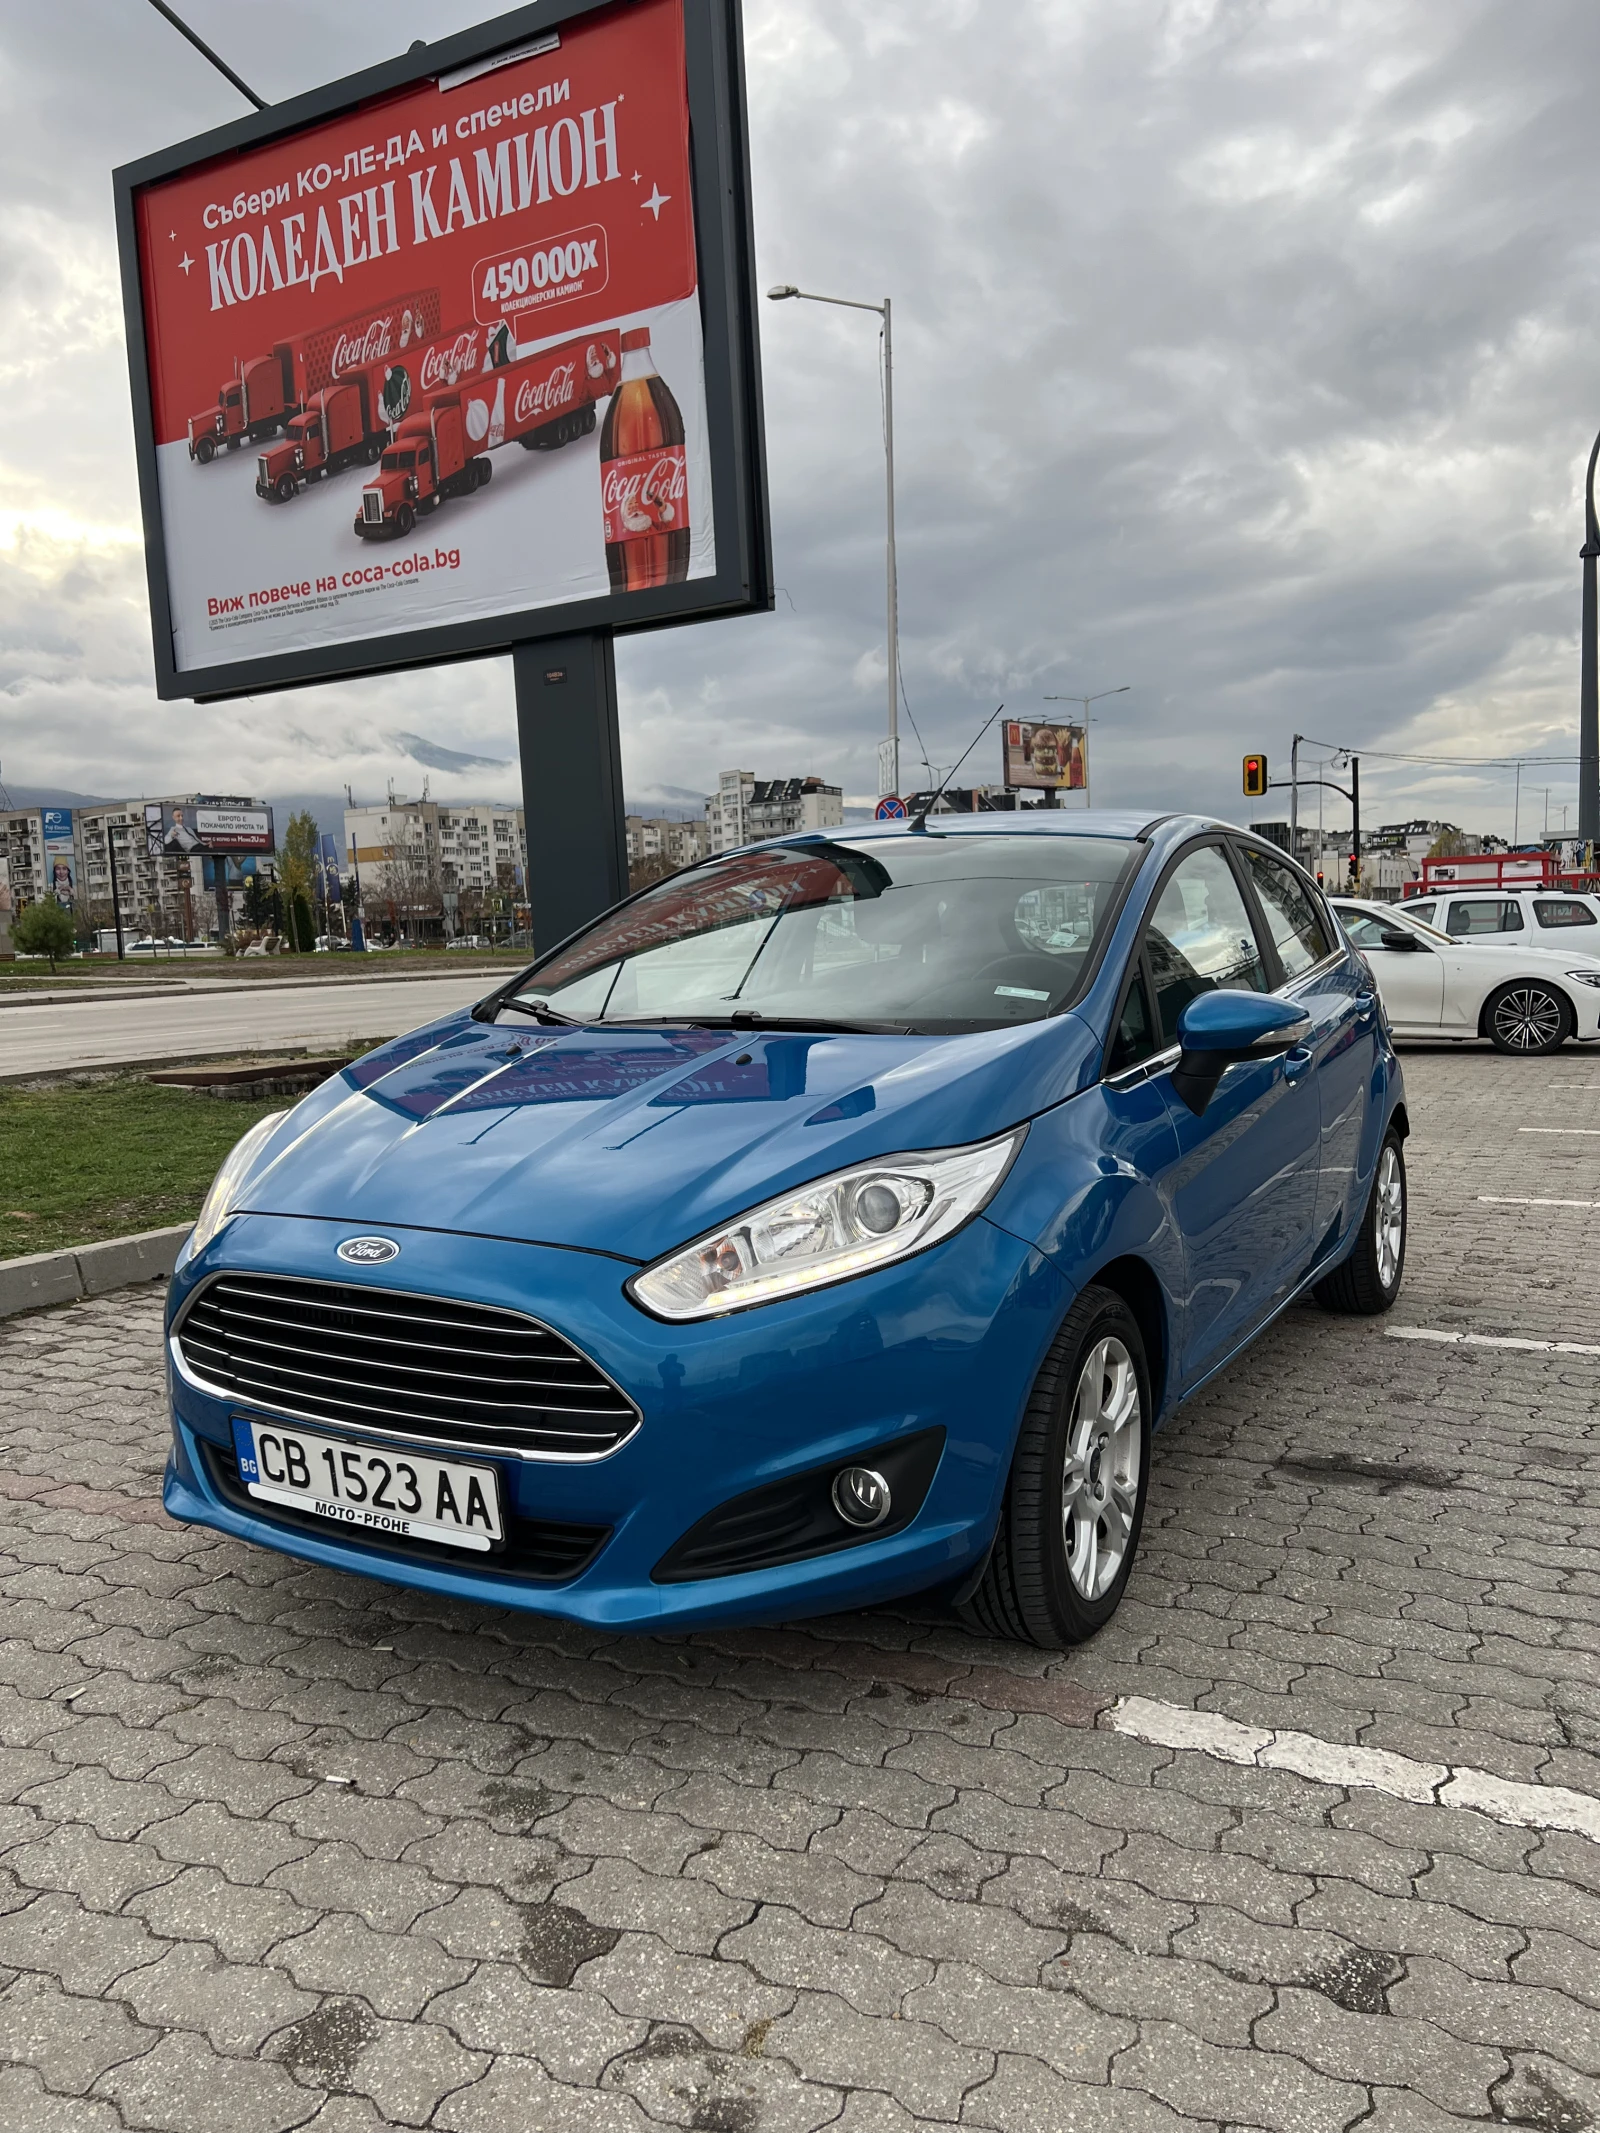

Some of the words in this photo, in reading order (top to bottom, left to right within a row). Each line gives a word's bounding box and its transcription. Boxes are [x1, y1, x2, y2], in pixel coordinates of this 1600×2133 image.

[203, 182, 290, 229] Събери
[297, 129, 425, 197] КО-ЛЕ-ДА
[432, 124, 448, 148] и
[456, 78, 570, 138] спечели
[205, 180, 400, 311] КОЛЕДЕН
[501, 289, 556, 313] КОЛЕКЦИОНЕРСКИ
[515, 361, 576, 423] Coca-Cola
[617, 456, 646, 467] ORIGINAL
[648, 451, 667, 460] TASTE
[603, 455, 686, 514] Coca-Cola
[207, 596, 245, 616] Виж
[249, 581, 311, 607] повече
[316, 576, 337, 593] на
[342, 548, 460, 587] coca-cola.bg
[200, 822, 234, 830] ПОКАЧИЛО
[348, 1241, 386, 1258] Ford
[240, 1456, 257, 1474] BG
[258, 1433, 311, 1490] CB
[322, 1447, 422, 1514] 1523
[435, 1469, 494, 1531] AA
[315, 1501, 410, 1534] MOTO-PFOHE
